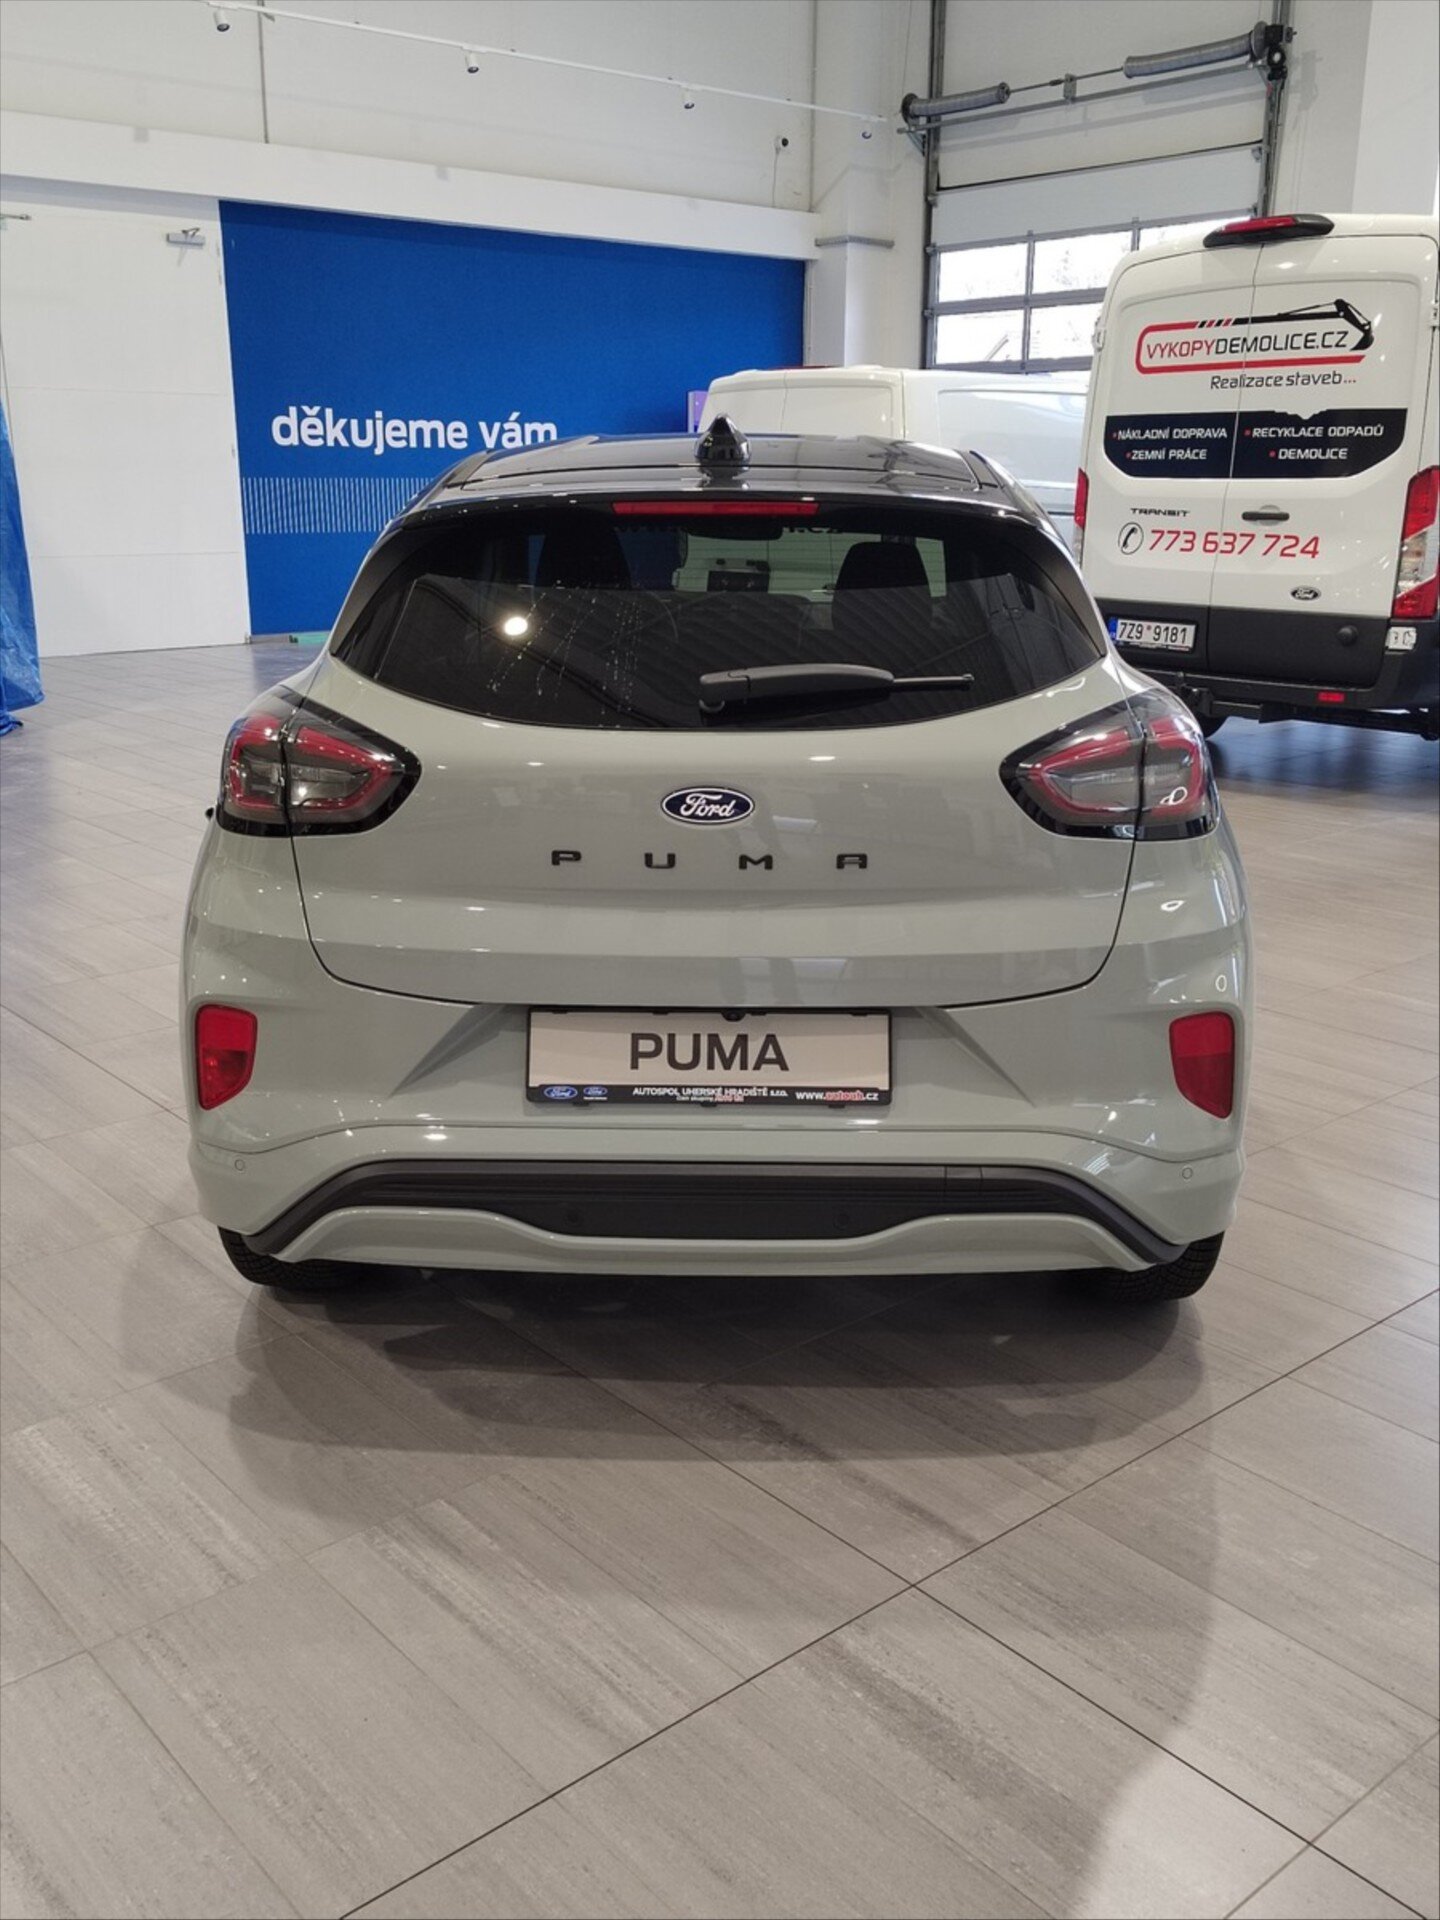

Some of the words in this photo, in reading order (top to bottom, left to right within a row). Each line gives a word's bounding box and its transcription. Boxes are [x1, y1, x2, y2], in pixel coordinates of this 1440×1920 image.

[1146, 331, 1350, 361] VYKOPYDEMOLICE.CZ
[1210, 373, 1283, 390] Realizace
[271, 405, 468, 455] děkujeme
[479, 411, 558, 449] vám
[1117, 427, 1170, 440] NÁKLADNÍ
[1172, 427, 1228, 439] DOPRAVA
[1252, 427, 1324, 438] RECYKLACE
[1327, 423, 1385, 437] ODPADŮ
[1131, 448, 1166, 460] ZEMNÍ
[1168, 447, 1208, 460] PRÁCE
[1278, 448, 1348, 460] DEMOLICE
[1130, 507, 1191, 517] TRANSIT
[1150, 529, 1196, 553] 773
[1203, 532, 1256, 555] 637
[1263, 535, 1320, 559] 724
[1119, 622, 1143, 640] 7Z9
[1153, 625, 1187, 644] 9181
[630, 1033, 789, 1071] PUMA
[632, 1088, 680, 1097] AUTOSPOL
